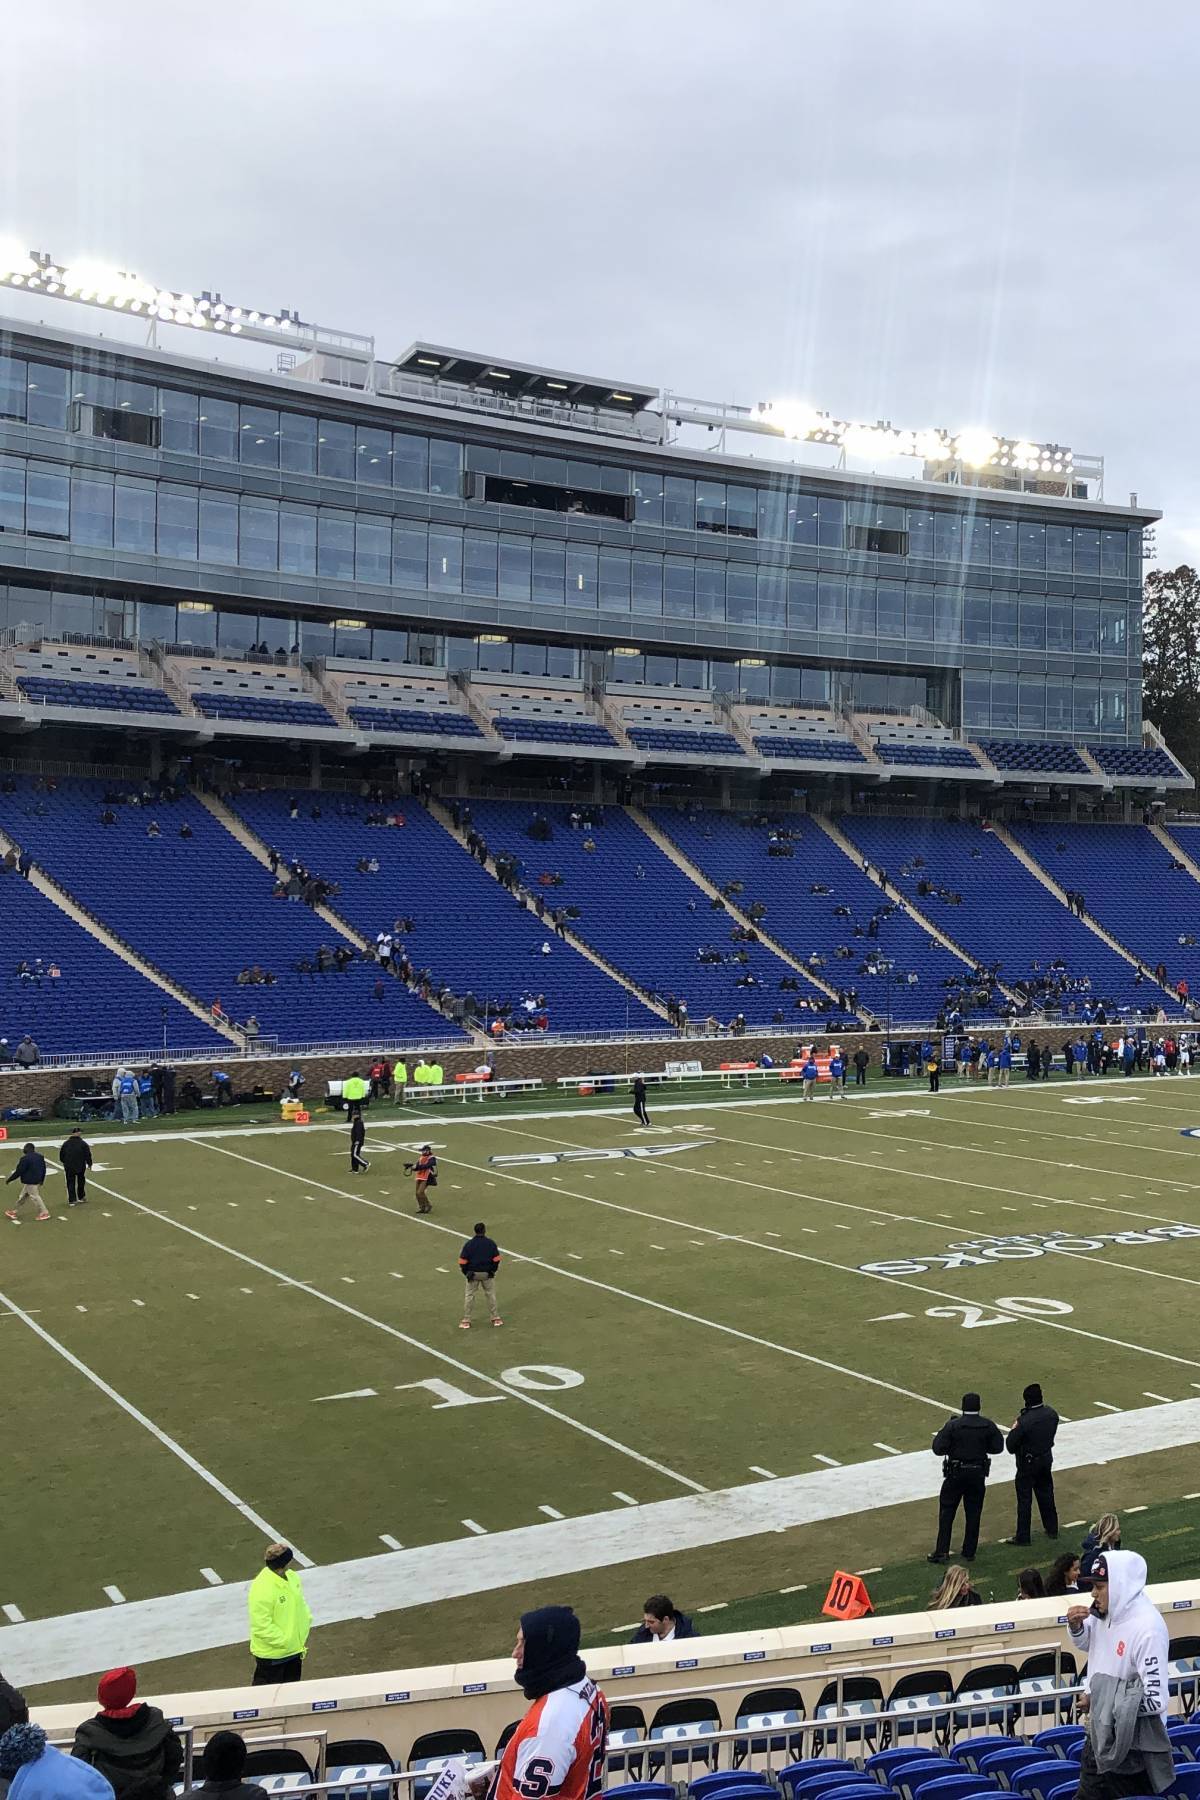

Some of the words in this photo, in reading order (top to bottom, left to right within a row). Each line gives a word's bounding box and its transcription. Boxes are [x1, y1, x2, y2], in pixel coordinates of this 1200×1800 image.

[924, 1296, 1075, 1329] 20
[393, 1365, 585, 1410] 10
[829, 1576, 854, 1611] 10
[519, 1757, 554, 1799] S
